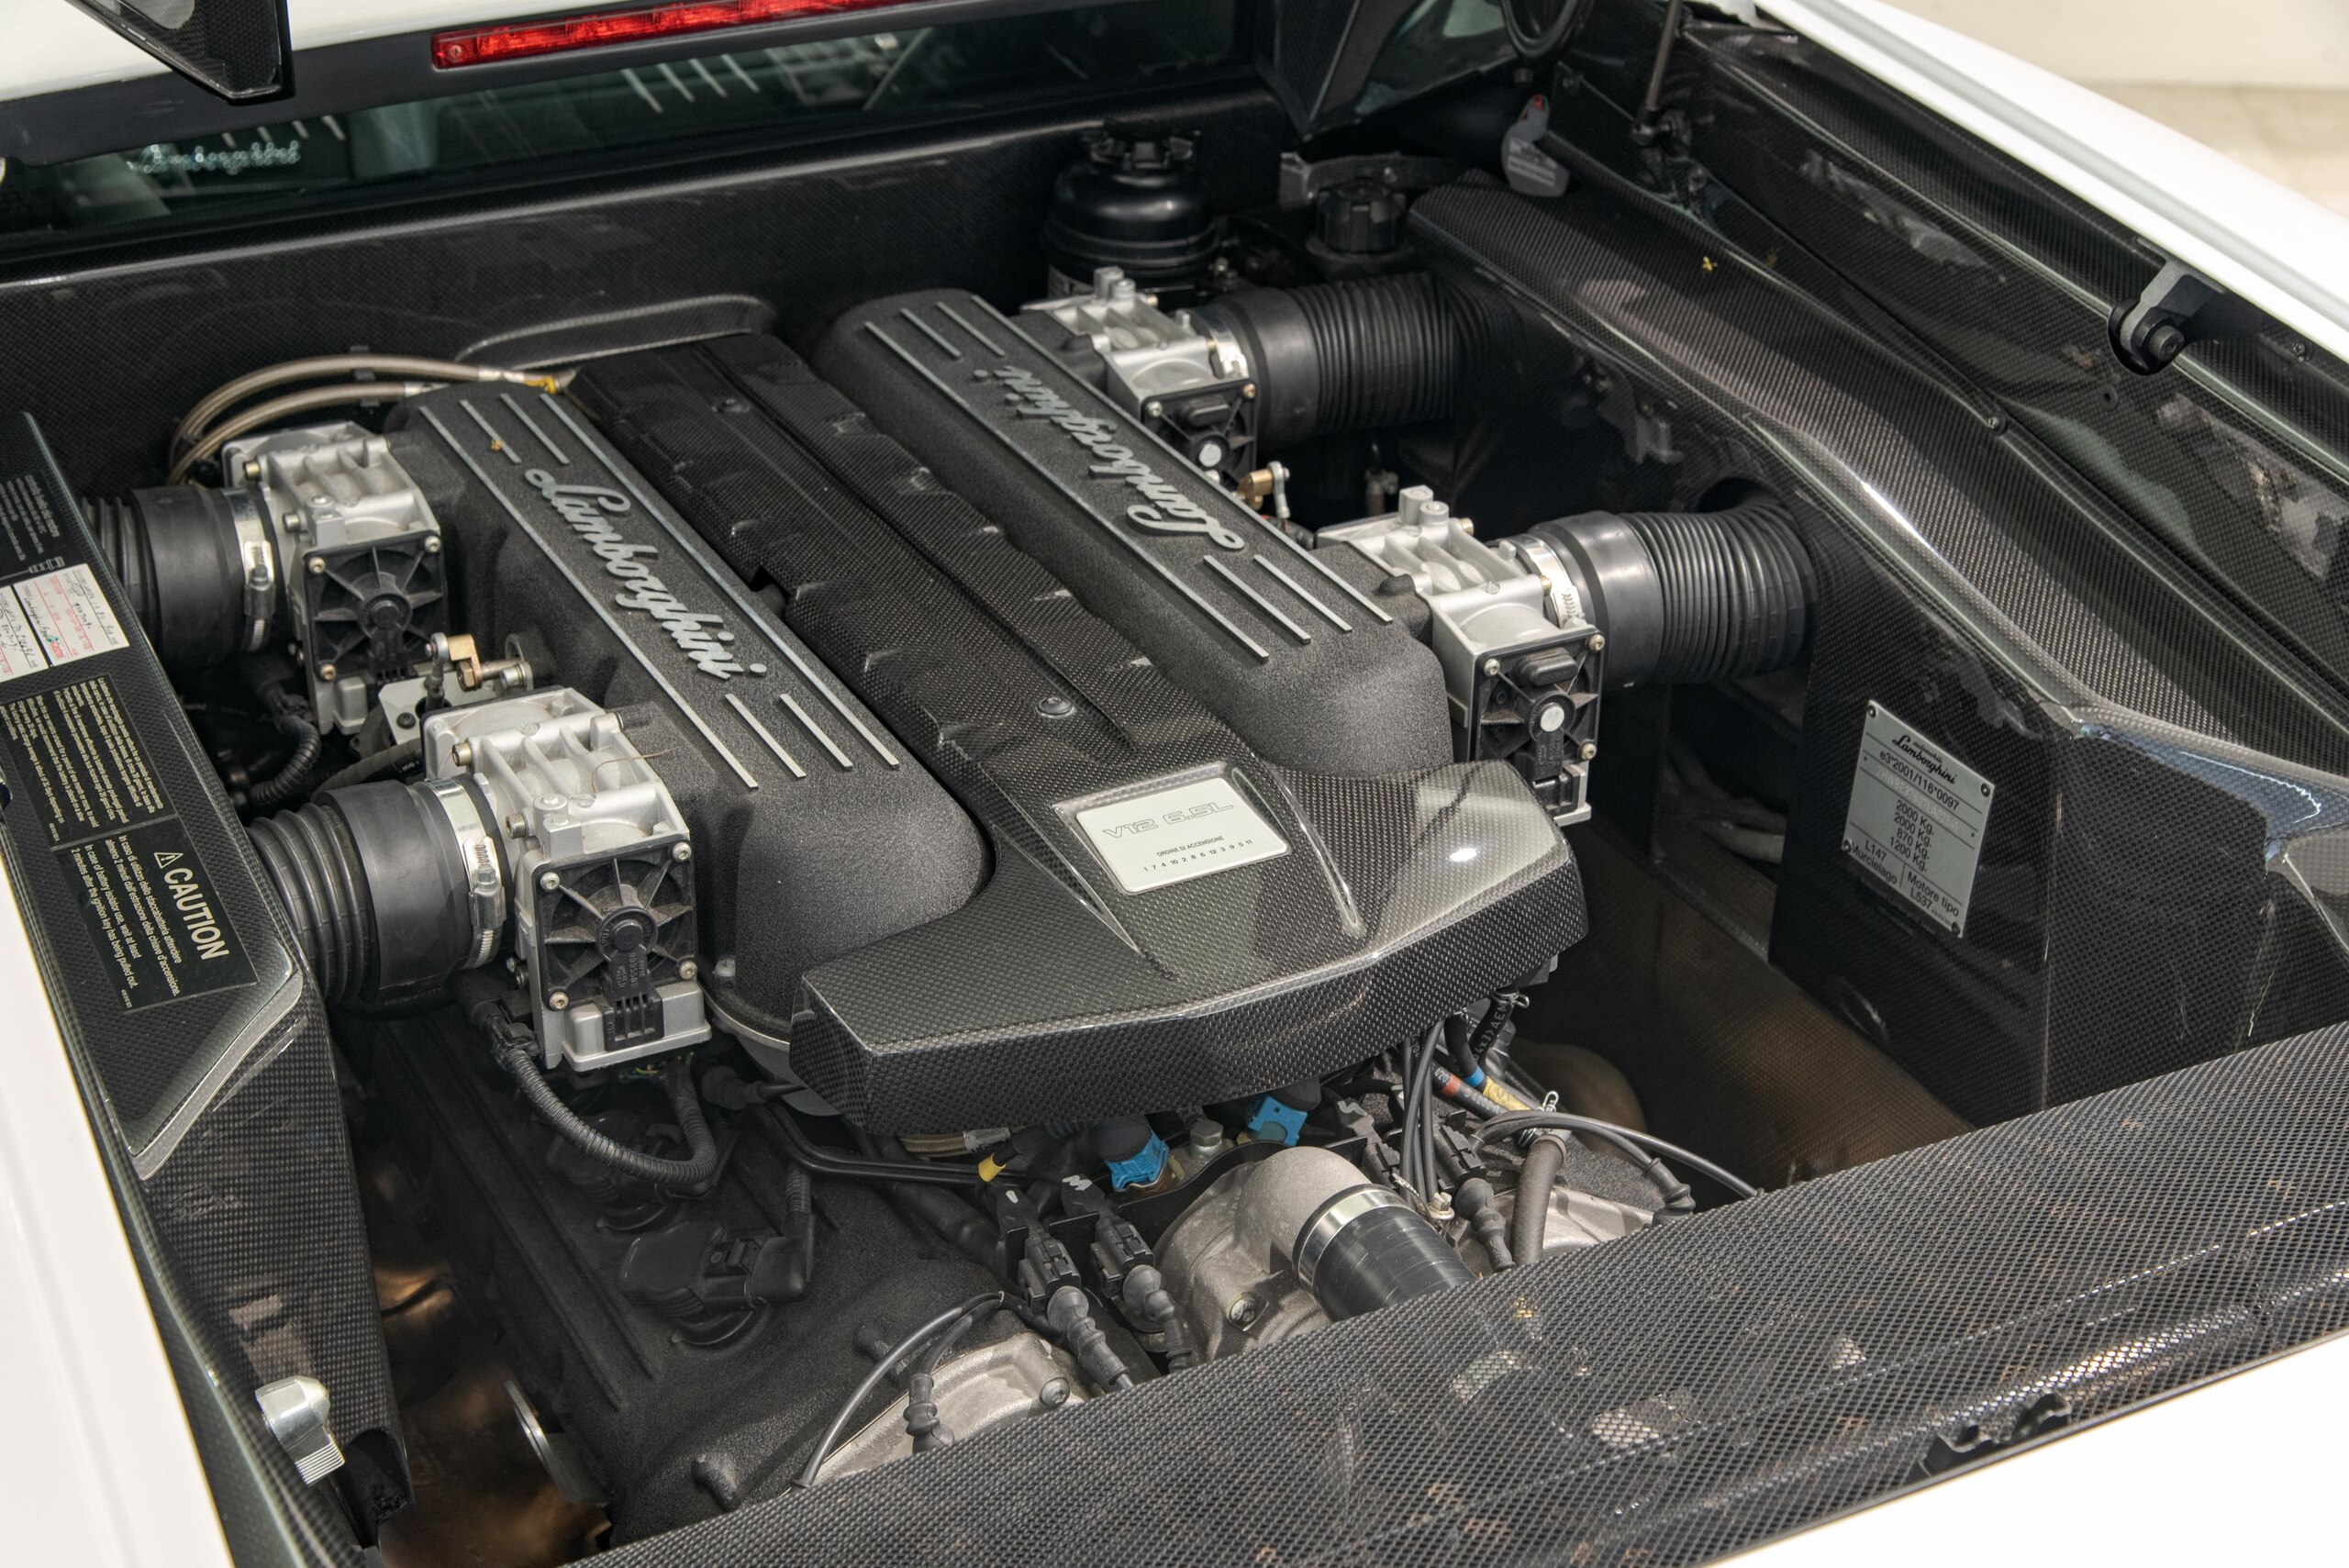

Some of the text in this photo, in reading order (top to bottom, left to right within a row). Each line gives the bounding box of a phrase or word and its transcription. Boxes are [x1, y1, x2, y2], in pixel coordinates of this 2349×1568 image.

[974, 365, 1244, 550] Lamborghini
[525, 469, 767, 680] Lamborghini
[1892, 734, 1957, 784] Lamborghini
[1101, 801, 1233, 838] V12 6.5L
[1893, 811, 1932, 847] 2000 Kg.
[1896, 799, 1934, 835] 2000 Kg.
[1156, 847, 1180, 857] ORDINE
[1186, 835, 1224, 850] ACCENSIONE
[1865, 839, 1887, 861] L147
[1890, 836, 1927, 871] 1200 Kg.
[1896, 827, 1930, 859] 870 Kg.
[72, 852, 87, 874] minutes
[82, 874, 94, 887] after
[88, 887, 97, 897] the
[1907, 870, 1958, 916] Motore tipo
[86, 851, 98, 864] case
[95, 870, 110, 890] battery
[105, 889, 119, 911] isolator
[114, 911, 124, 924] use,
[119, 923, 132, 937] wait
[128, 942, 141, 959] least
[91, 896, 106, 918] ignition
[121, 841, 132, 855] caso
[129, 861, 144, 881] utilizzo
[139, 881, 150, 895] dello
[145, 895, 169, 935] staccabatteria
[163, 935, 182, 962] attendere
[1909, 886, 1932, 908] L537
[101, 917, 111, 929] key
[105, 839, 118, 859] almeno
[116, 863, 131, 881] minuti
[124, 881, 147, 920] dall'estrazione
[141, 920, 153, 935] della
[148, 935, 161, 954] chiave
[157, 954, 180, 995] d'accensione.
[163, 868, 229, 959] CAUTION
[106, 929, 117, 940] has
[111, 940, 124, 958] being
[116, 957, 134, 976] pulled
[127, 975, 138, 988] out.
